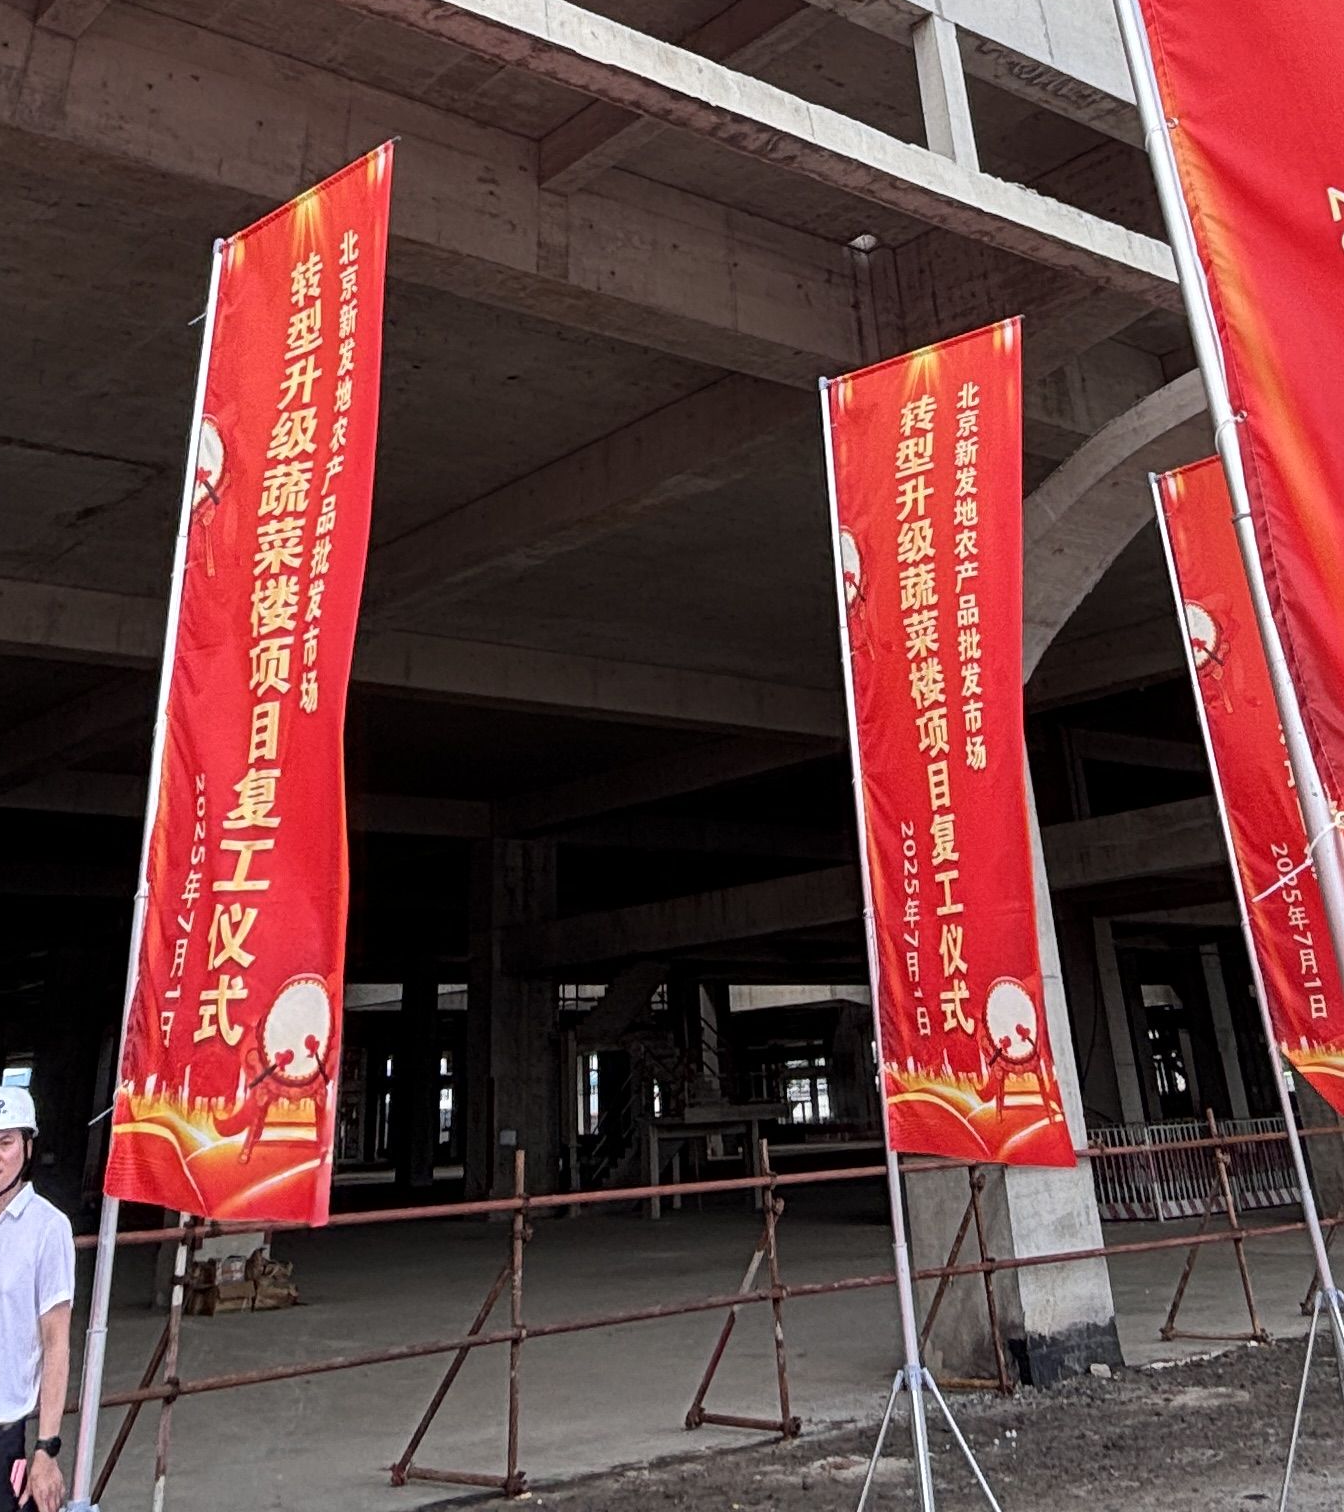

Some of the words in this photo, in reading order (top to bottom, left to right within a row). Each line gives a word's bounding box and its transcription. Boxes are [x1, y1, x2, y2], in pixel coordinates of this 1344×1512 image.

[193, 252, 323, 1048] 转型升级蔬菜楼项目复工仪式
[299, 229, 360, 715] 北京新发地农产品批发市场
[894, 394, 975, 1035] 转型升级蔬菜楼项目复工仪式
[953, 381, 988, 771] 北京新发地农产品批发市场
[901, 821, 931, 1036] 2025年7月1日
